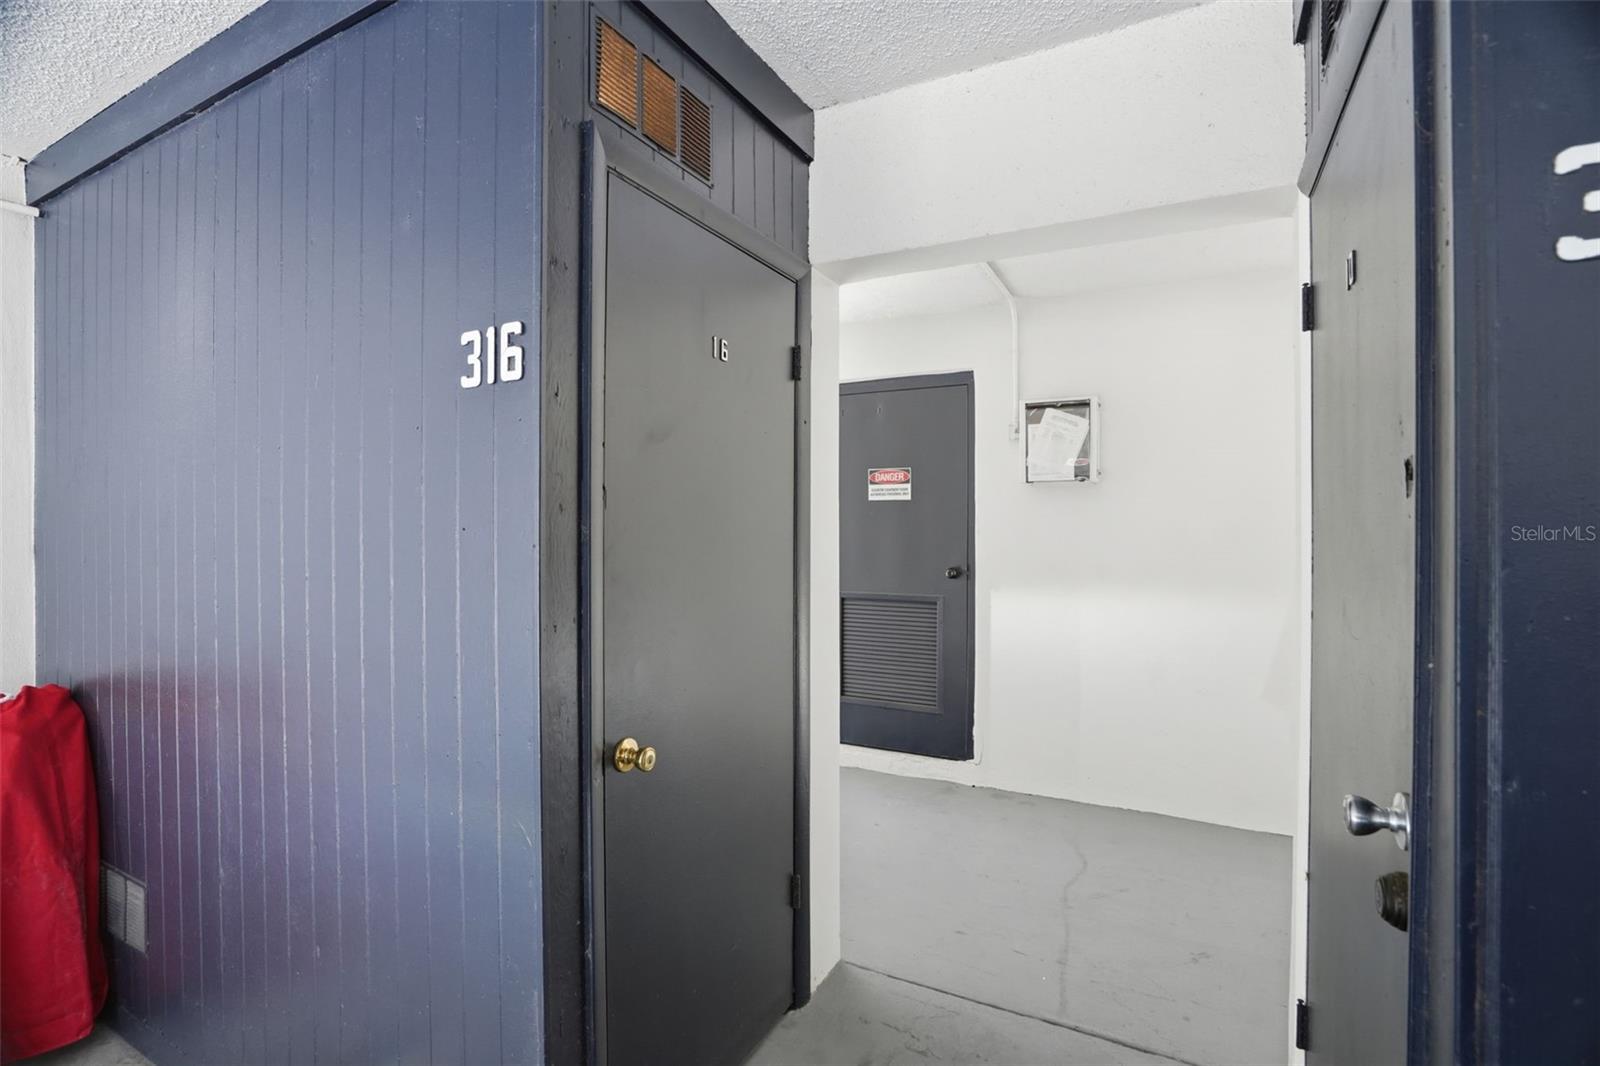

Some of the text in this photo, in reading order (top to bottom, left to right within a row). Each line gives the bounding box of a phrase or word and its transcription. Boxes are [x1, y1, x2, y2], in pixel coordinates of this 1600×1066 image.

[460, 320, 524, 388] 316
[712, 335, 729, 362] 16
[875, 472, 905, 482] DANGER
